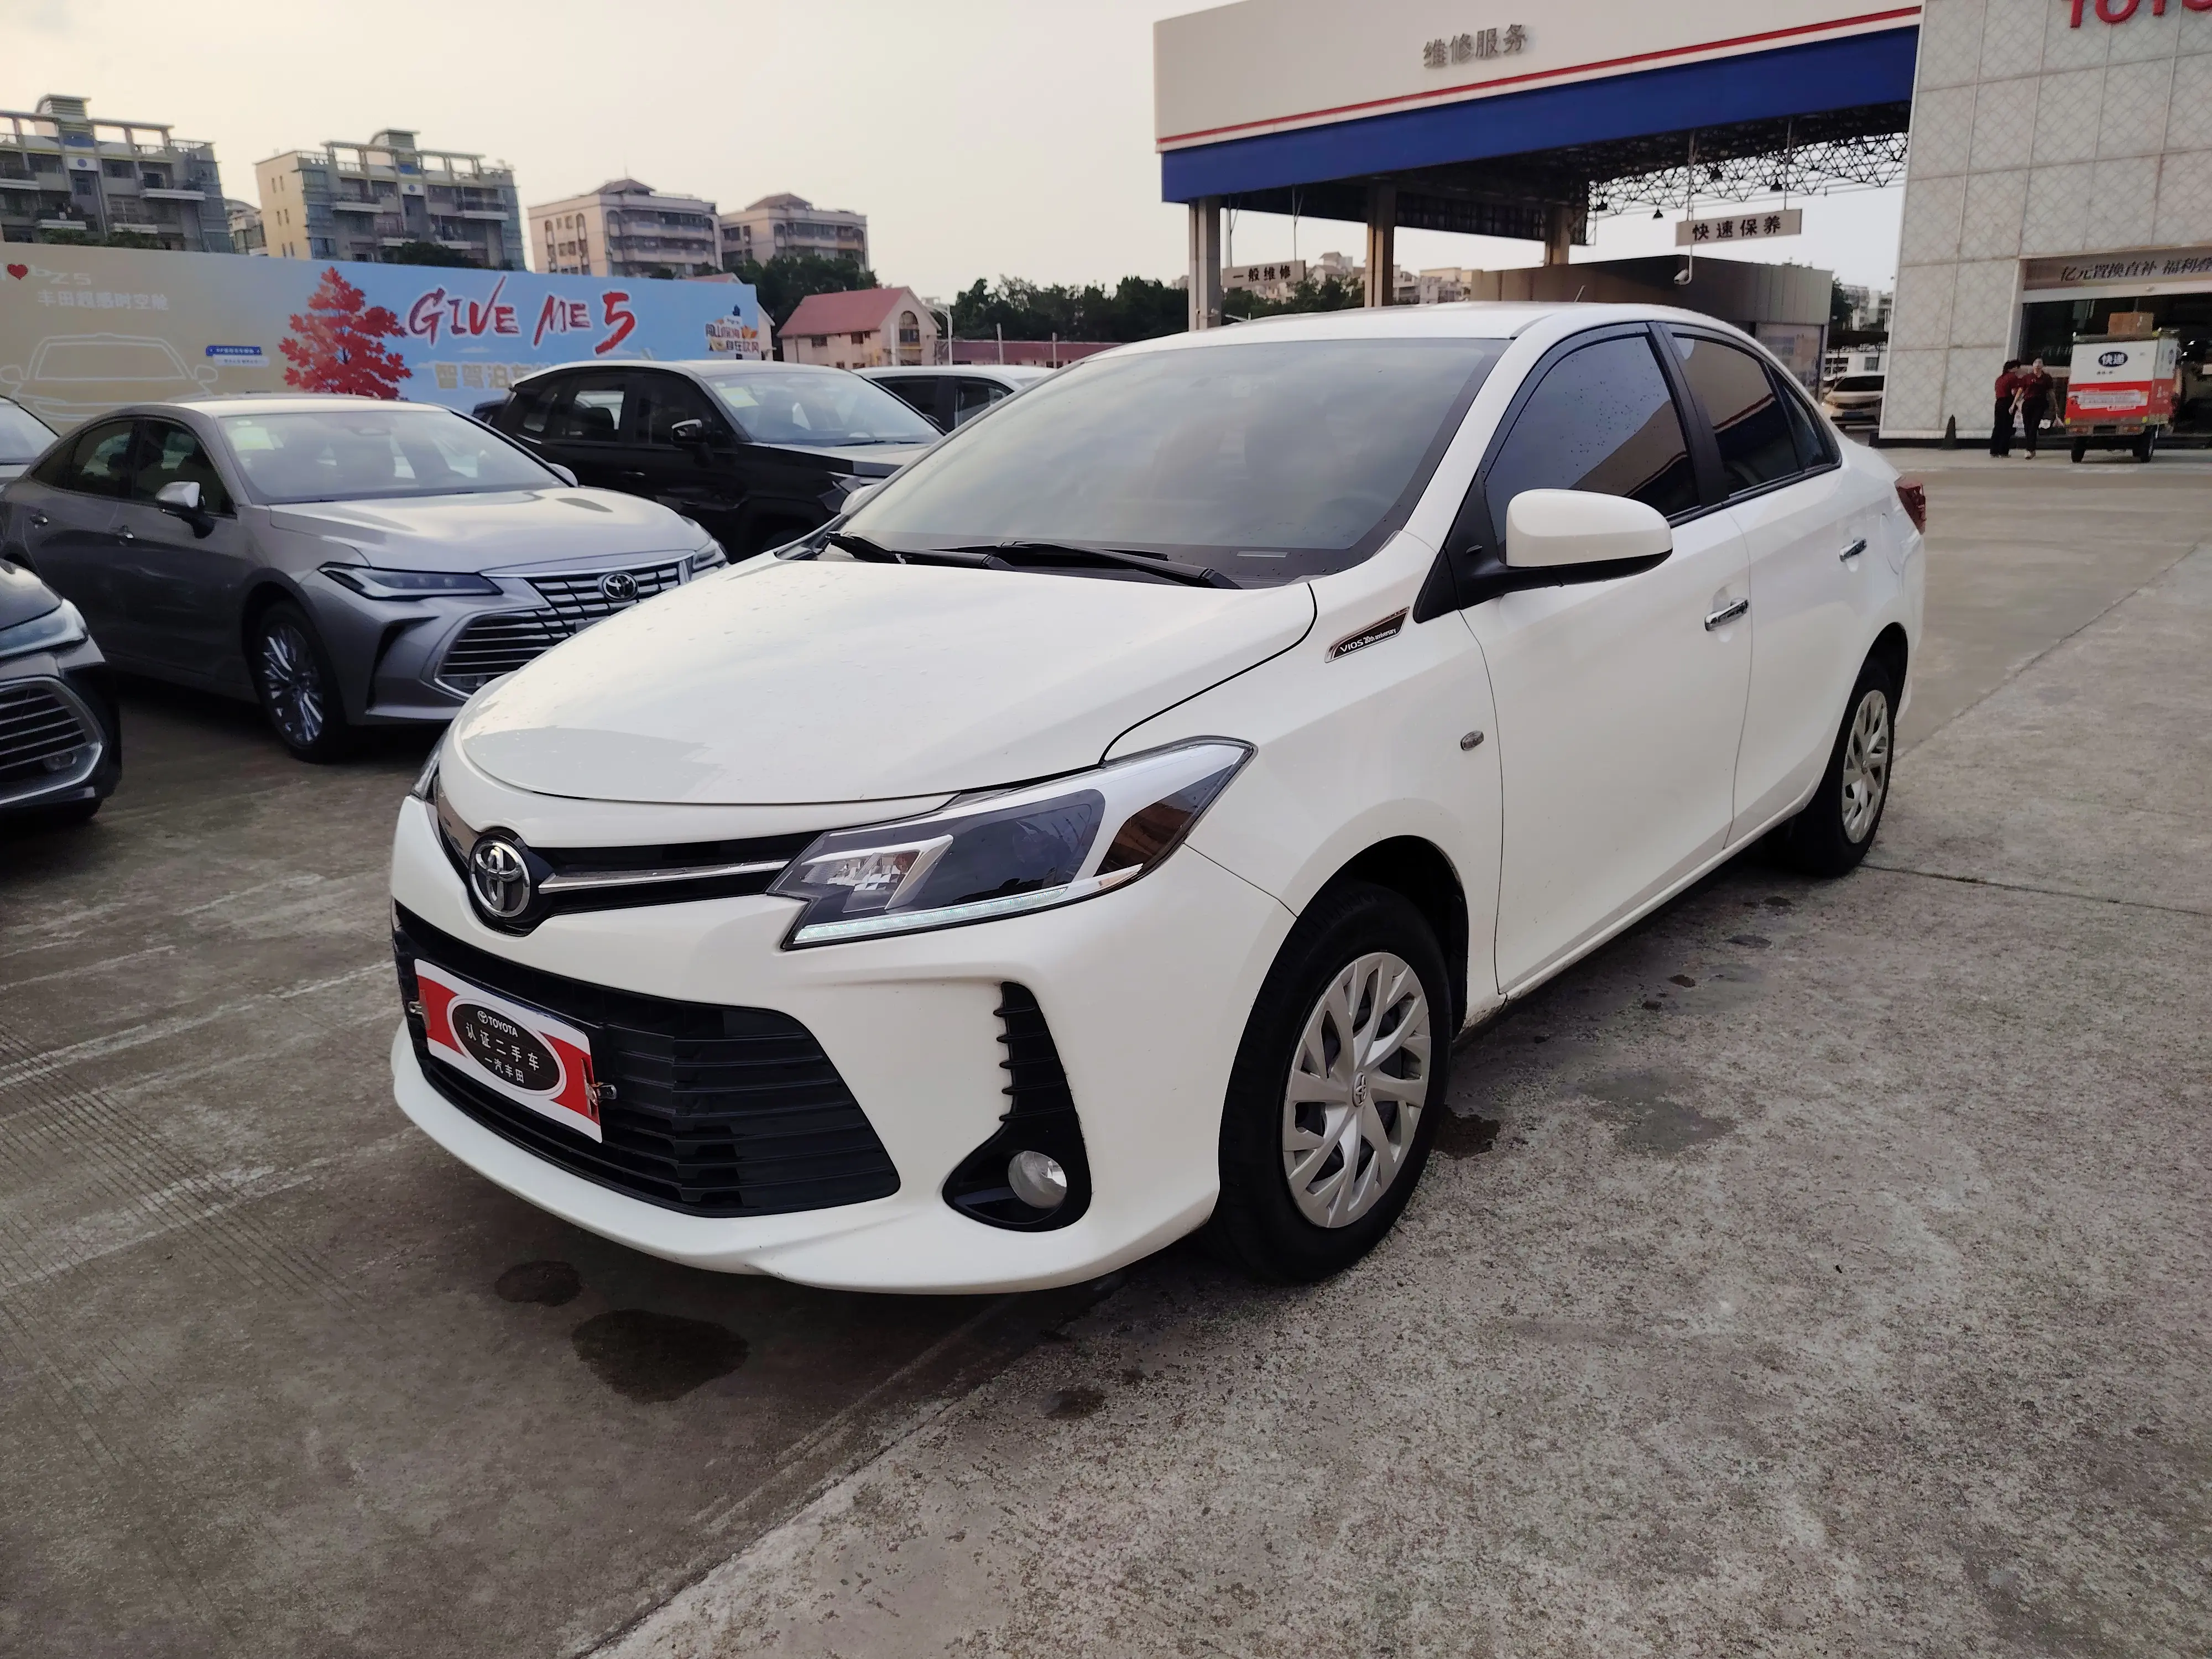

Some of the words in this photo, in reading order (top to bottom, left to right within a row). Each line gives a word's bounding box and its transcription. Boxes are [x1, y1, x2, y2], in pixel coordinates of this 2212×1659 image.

[1423, 24, 1528, 66] 维修服务
[1692, 215, 1781, 242] 快速保养
[1233, 264, 1291, 283] 一般维修
[409, 275, 519, 346] GIVE
[533, 295, 590, 346] ME
[595, 291, 635, 354] 5
[1339, 639, 1364, 653] VIOS
[1363, 635, 1375, 645] 20th
[1374, 628, 1396, 640] anniversary
[488, 1015, 519, 1038] TOYOTA
[466, 1022, 540, 1072] 认证二手车
[484, 1057, 525, 1084] 一汽丰田
